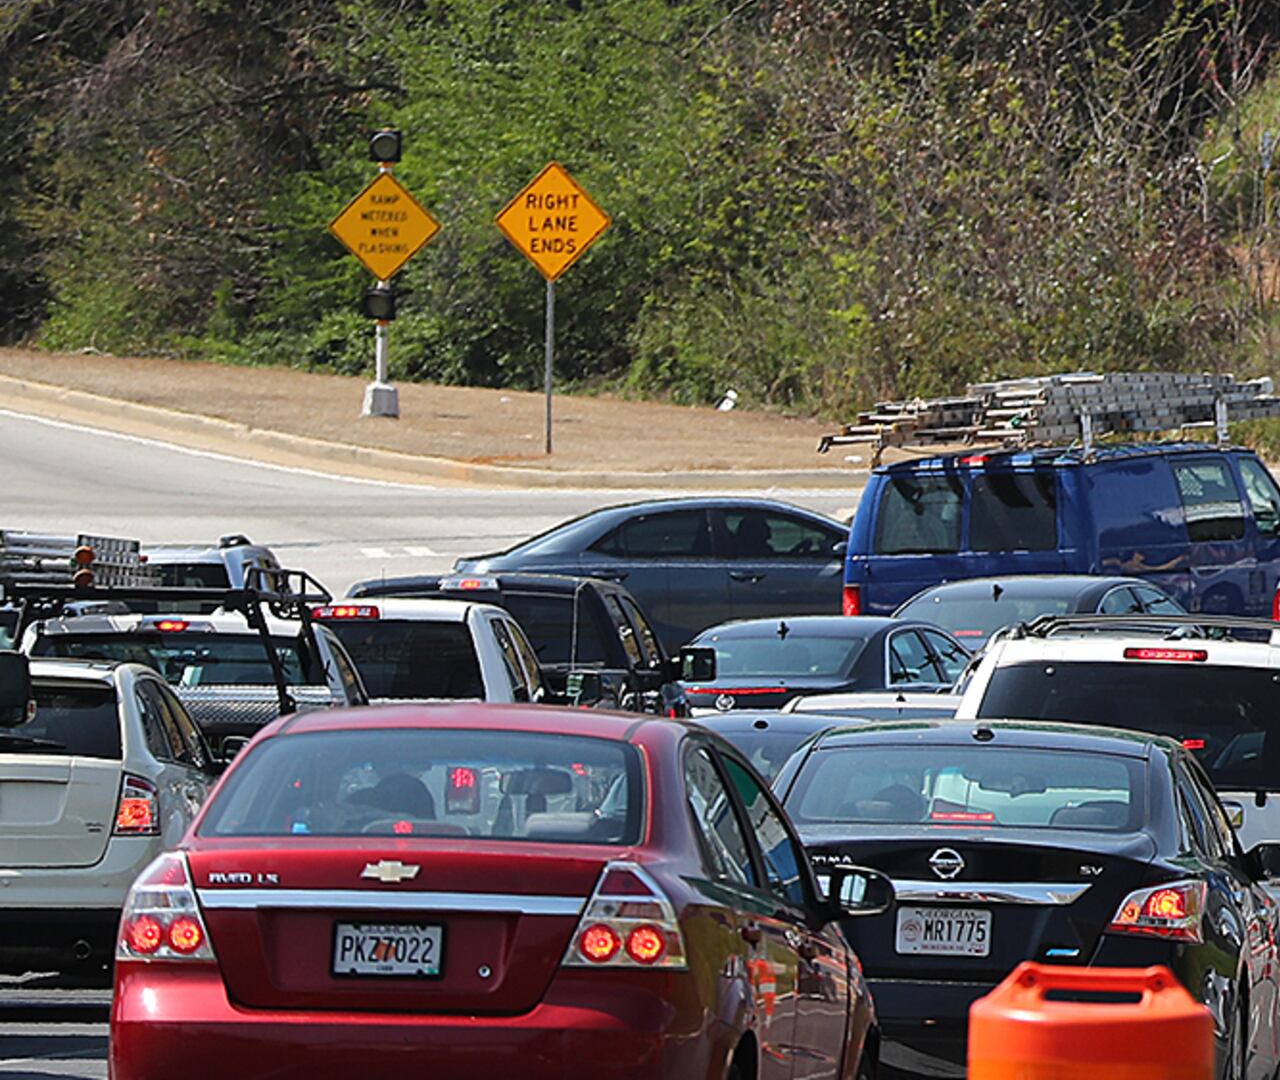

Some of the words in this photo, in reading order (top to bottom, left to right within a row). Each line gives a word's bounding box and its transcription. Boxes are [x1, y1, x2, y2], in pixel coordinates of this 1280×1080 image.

[525, 193, 580, 210] RIGHT
[528, 217, 578, 232] LANE
[530, 239, 577, 254] ENDS
[1079, 865, 1104, 876] SV
[340, 935, 434, 964] PKZ7022
